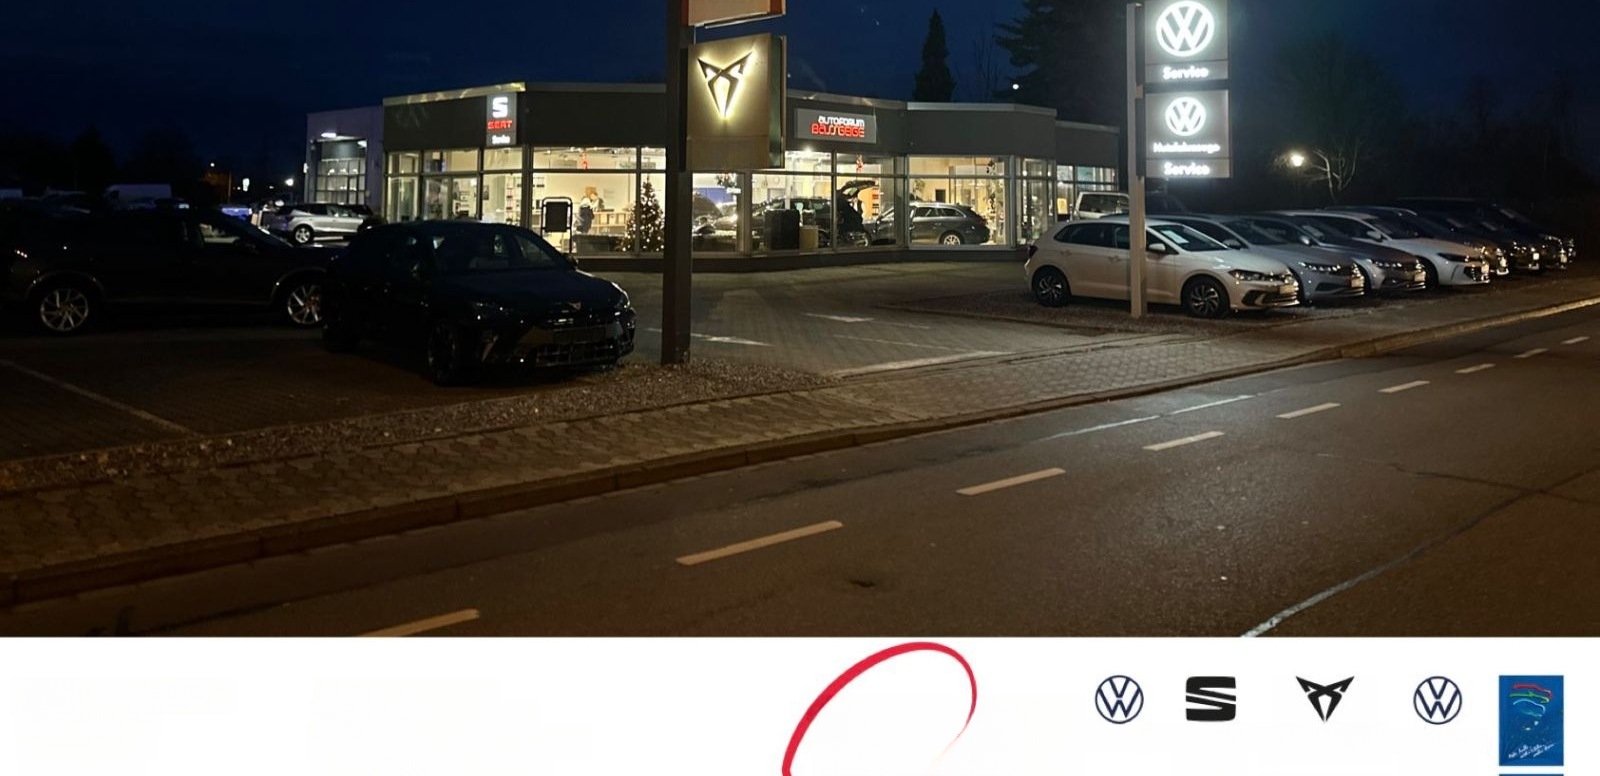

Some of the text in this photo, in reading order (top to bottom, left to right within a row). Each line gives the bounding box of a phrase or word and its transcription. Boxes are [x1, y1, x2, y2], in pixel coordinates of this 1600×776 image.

[1163, 66, 1209, 79] Service
[487, 120, 513, 130] SEAT
[818, 115, 865, 128] AUTOFORUM
[1164, 162, 1210, 175] Service
